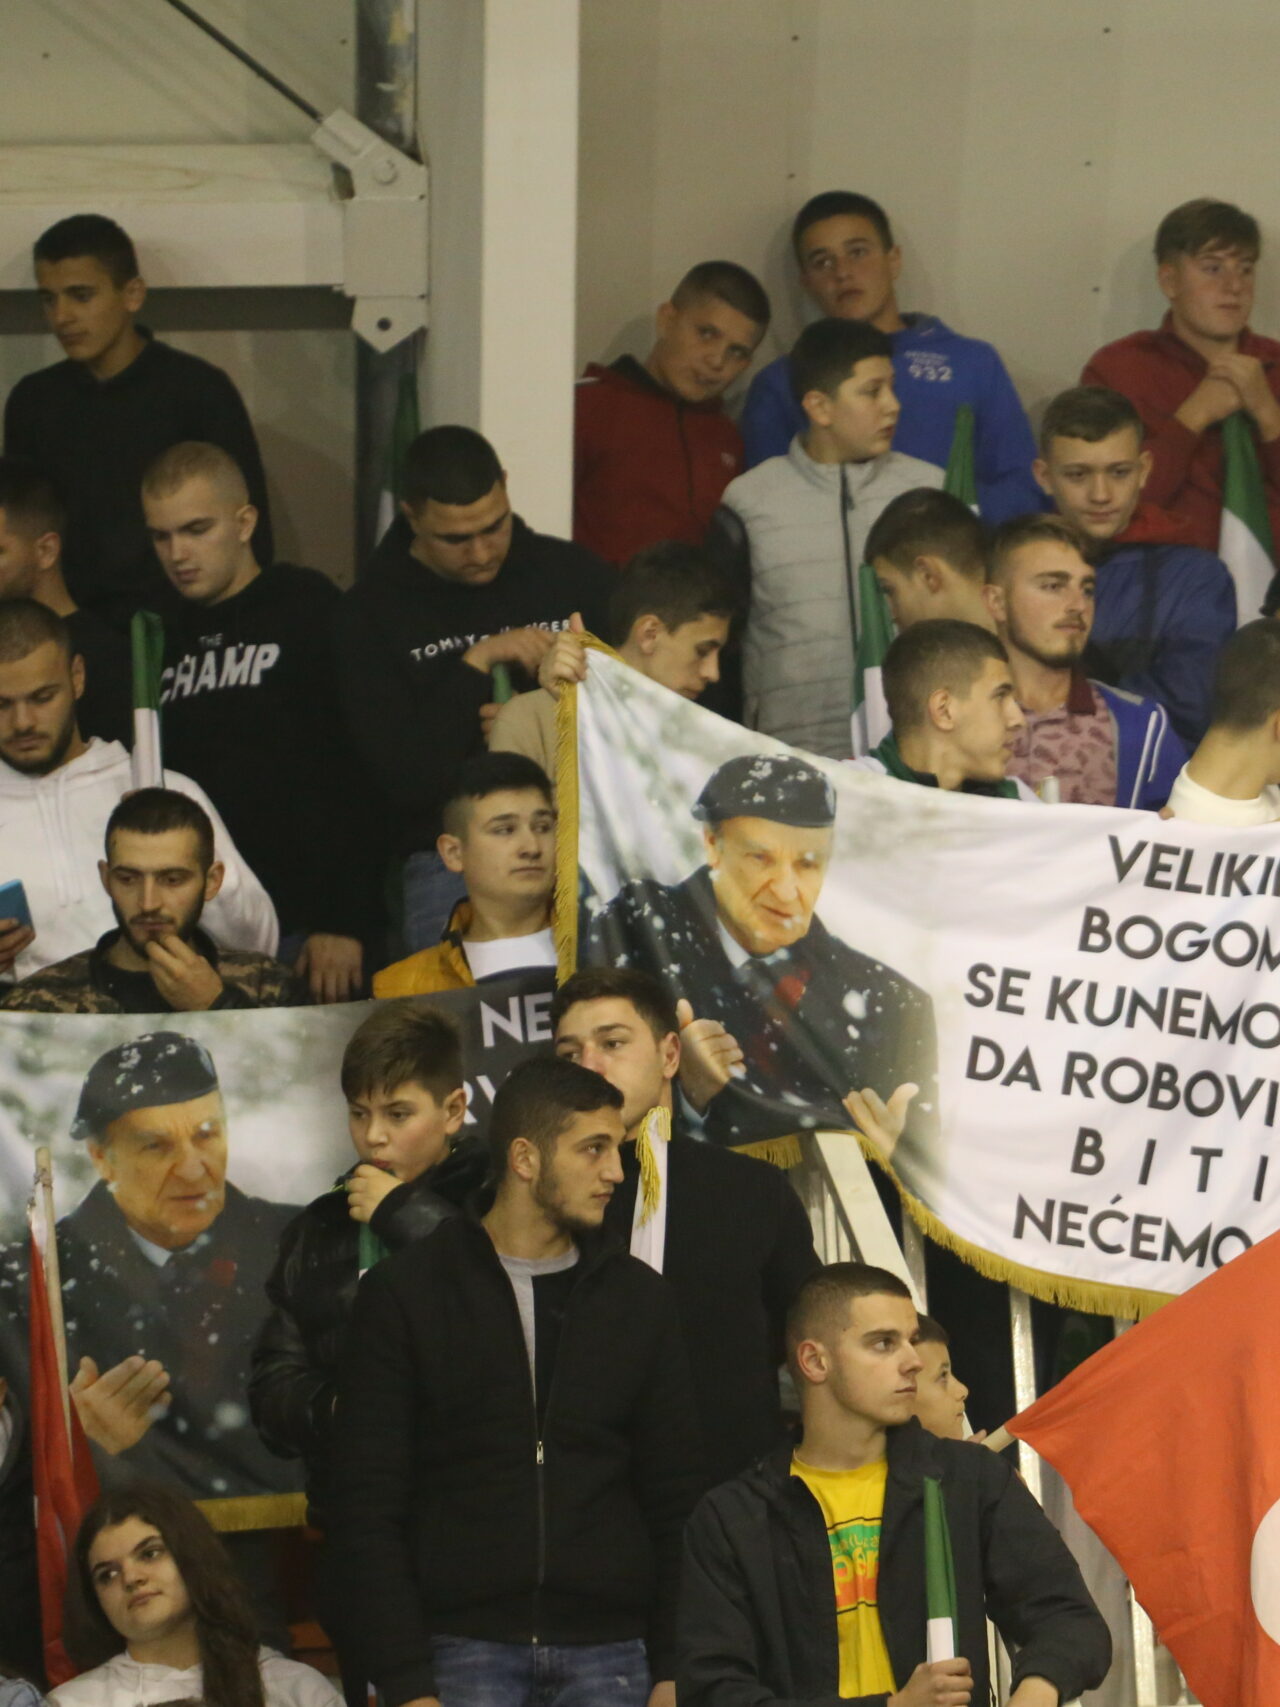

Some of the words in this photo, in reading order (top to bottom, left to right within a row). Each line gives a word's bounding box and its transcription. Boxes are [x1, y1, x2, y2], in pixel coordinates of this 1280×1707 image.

[410, 634, 476, 662] TOMMY
[964, 962, 1031, 1016] SE
[965, 1036, 1041, 1092] DA
[1061, 1051, 1280, 1127] ROBOVI
[1012, 1193, 1253, 1269] NEĆEMO
